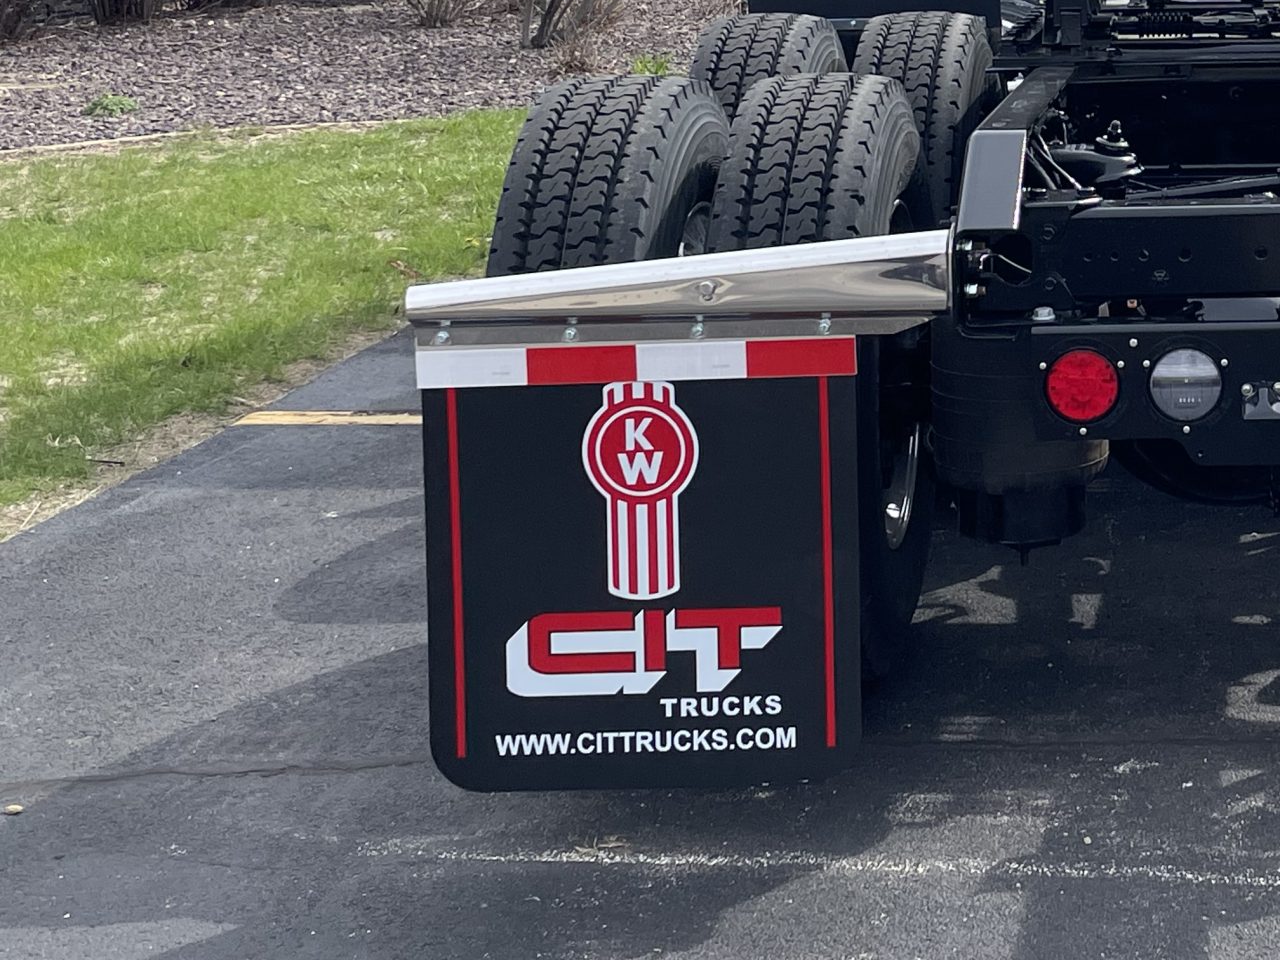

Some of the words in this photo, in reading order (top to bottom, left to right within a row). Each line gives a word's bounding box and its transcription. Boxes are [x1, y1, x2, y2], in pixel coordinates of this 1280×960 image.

[506, 607, 783, 697] CIT
[660, 695, 782, 718] TRUCKS
[495, 726, 797, 756] WWW.CITTRUCKS.COM
